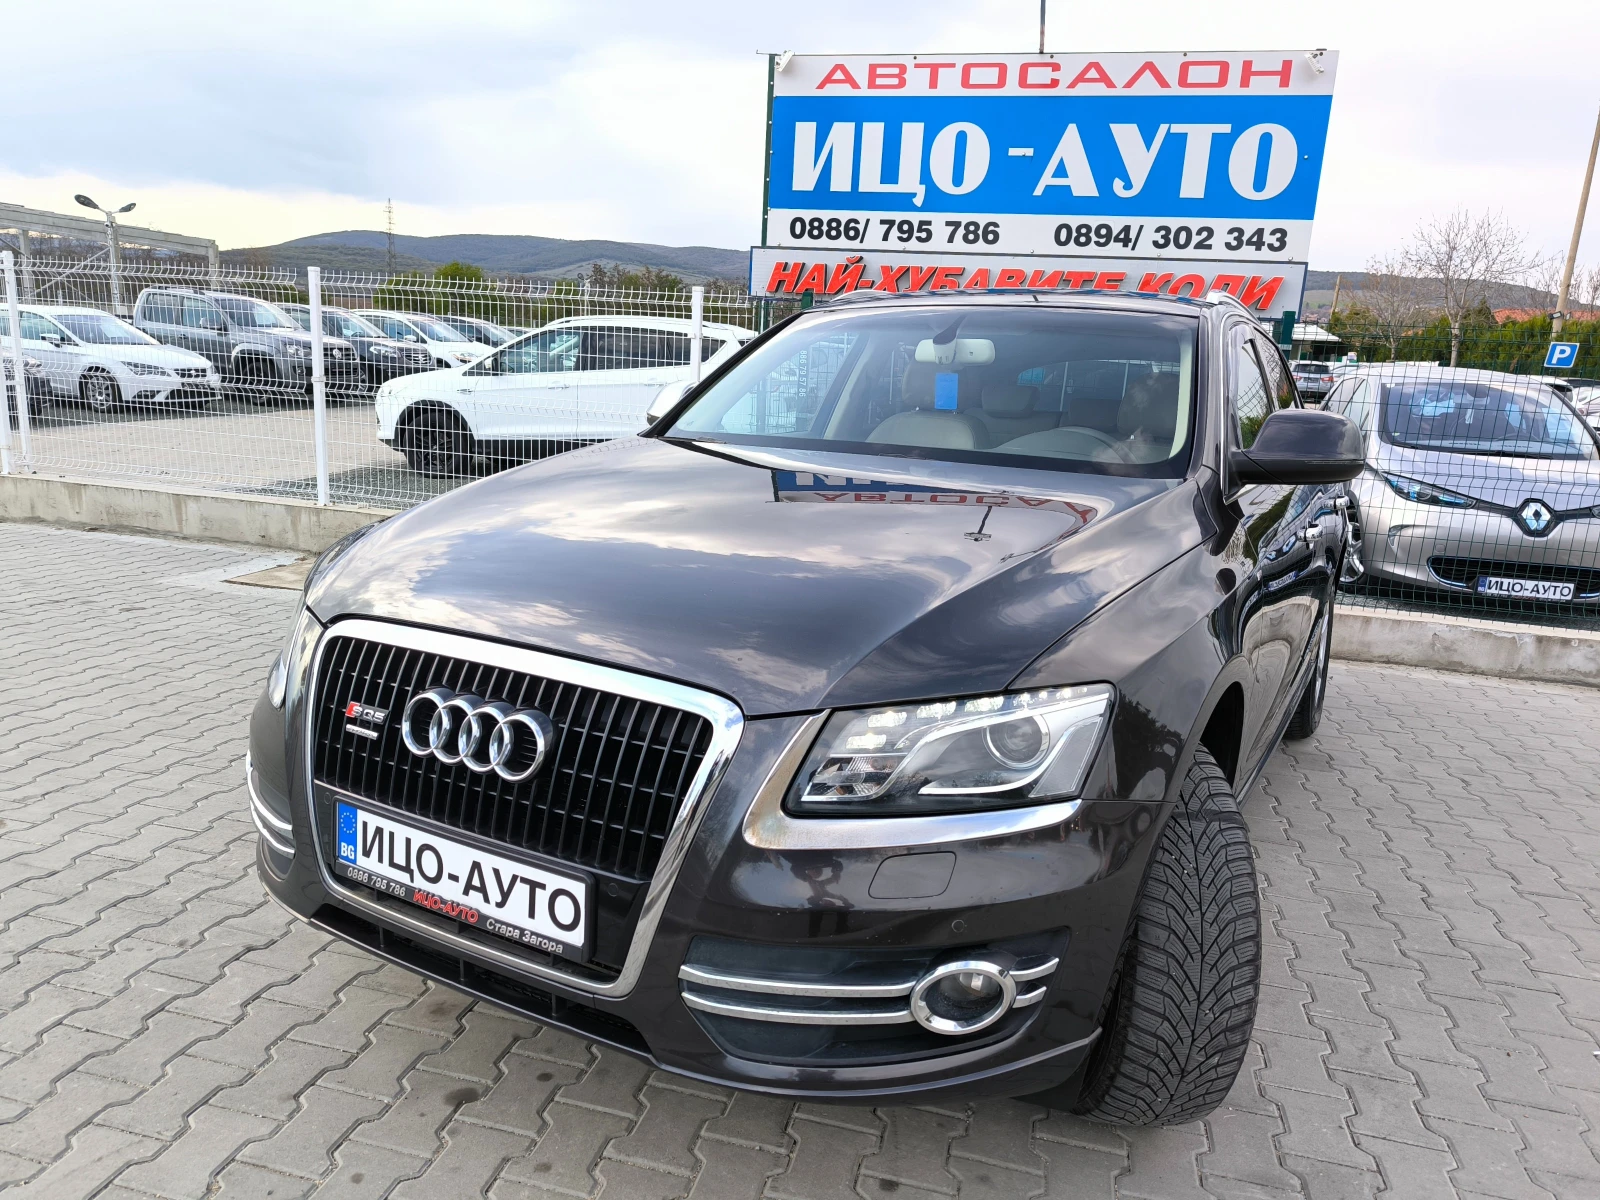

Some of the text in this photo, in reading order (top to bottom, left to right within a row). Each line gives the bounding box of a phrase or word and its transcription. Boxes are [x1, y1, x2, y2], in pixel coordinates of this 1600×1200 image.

[815, 60, 1293, 90] АВТОСАЛОН
[789, 216, 1288, 252] 0886/ 795 786 0894/ 302 343
[1551, 345, 1571, 364] P
[1487, 580, 1571, 597] ИЦО-АУТО
[351, 705, 386, 723] SQ5
[340, 842, 355, 860] BG
[361, 820, 582, 932] ИЦО-АУТО
[347, 867, 563, 954] 0886 795 786 ИЦО-АУТО Стара Загора
